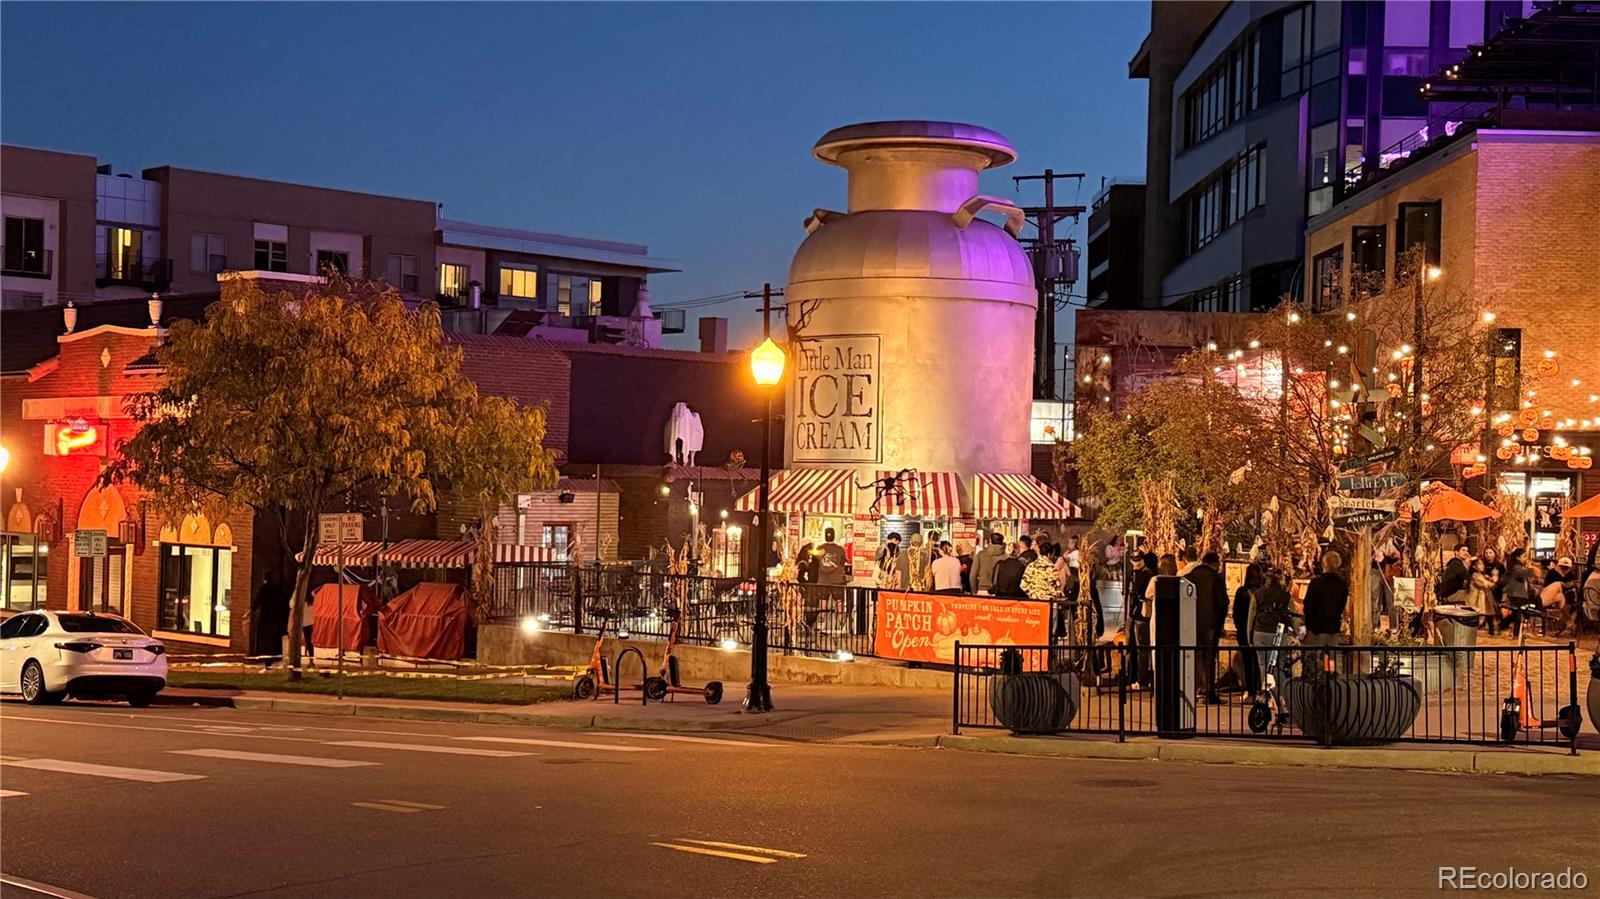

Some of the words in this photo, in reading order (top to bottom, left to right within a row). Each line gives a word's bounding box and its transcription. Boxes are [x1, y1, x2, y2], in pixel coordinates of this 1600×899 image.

[798, 346, 830, 371] Little
[834, 346, 872, 370] Man
[797, 373, 872, 419] ICE
[797, 421, 873, 450] CREAM
[1347, 515, 1372, 523] ANNA
[886, 598, 933, 614] PUMPKIN
[886, 612, 932, 632] PATCH
[891, 627, 930, 656] Open
